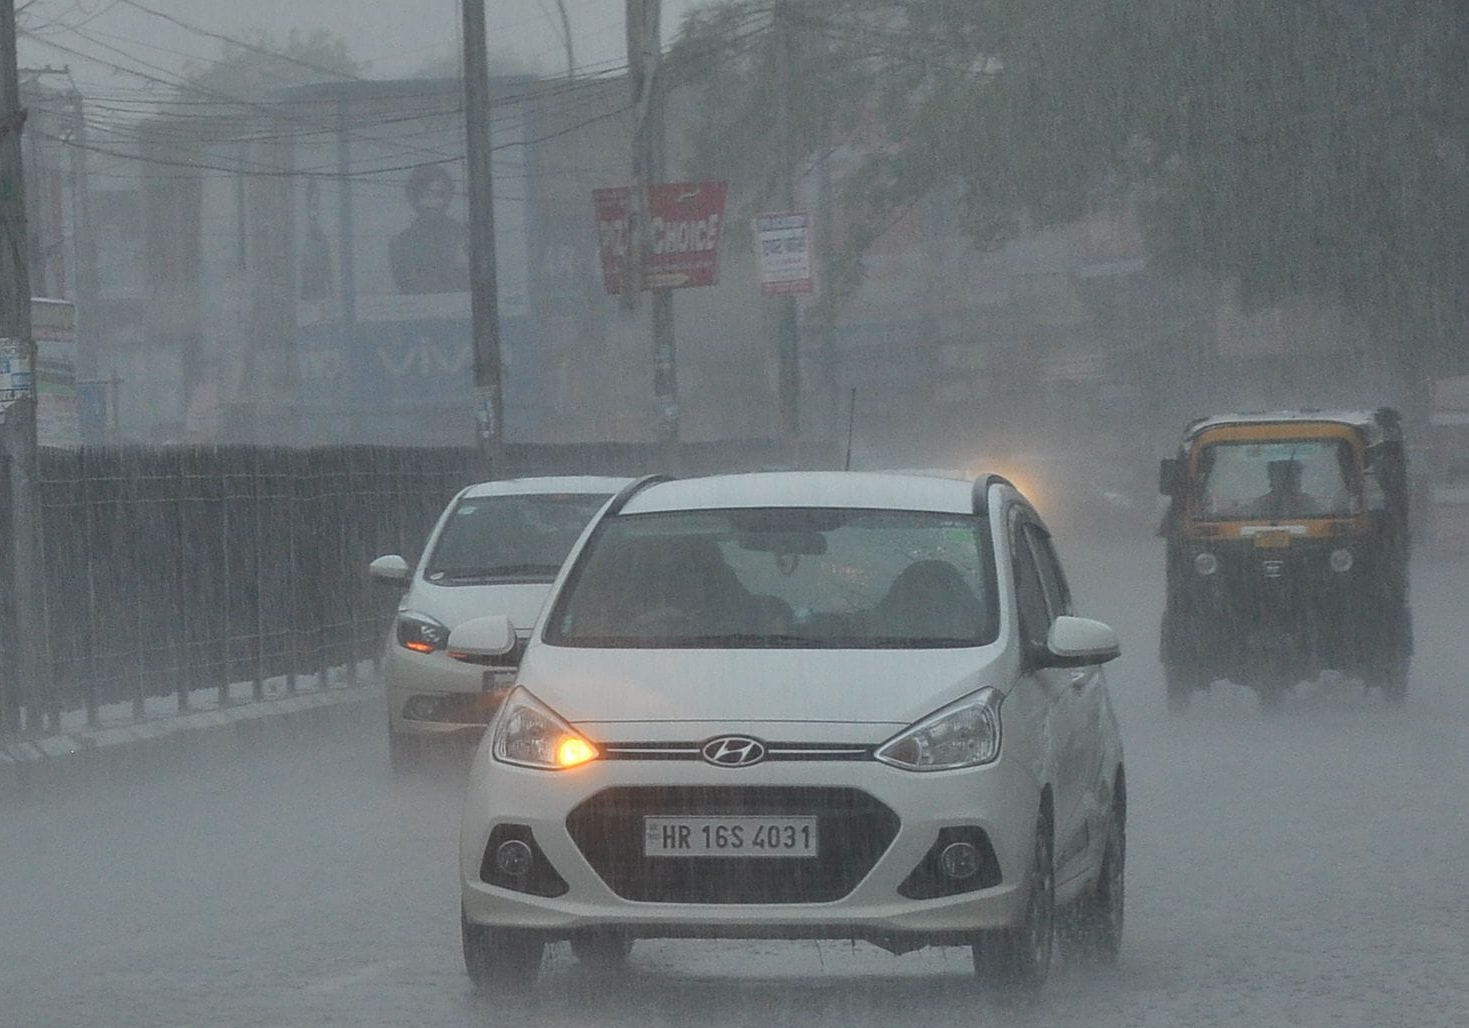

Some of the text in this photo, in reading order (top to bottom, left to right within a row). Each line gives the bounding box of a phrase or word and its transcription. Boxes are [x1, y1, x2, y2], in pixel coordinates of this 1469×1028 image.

[652, 214, 719, 254] CHOICE
[662, 825, 691, 849] HR
[702, 825, 744, 849] 16S
[752, 825, 810, 849] 4031
